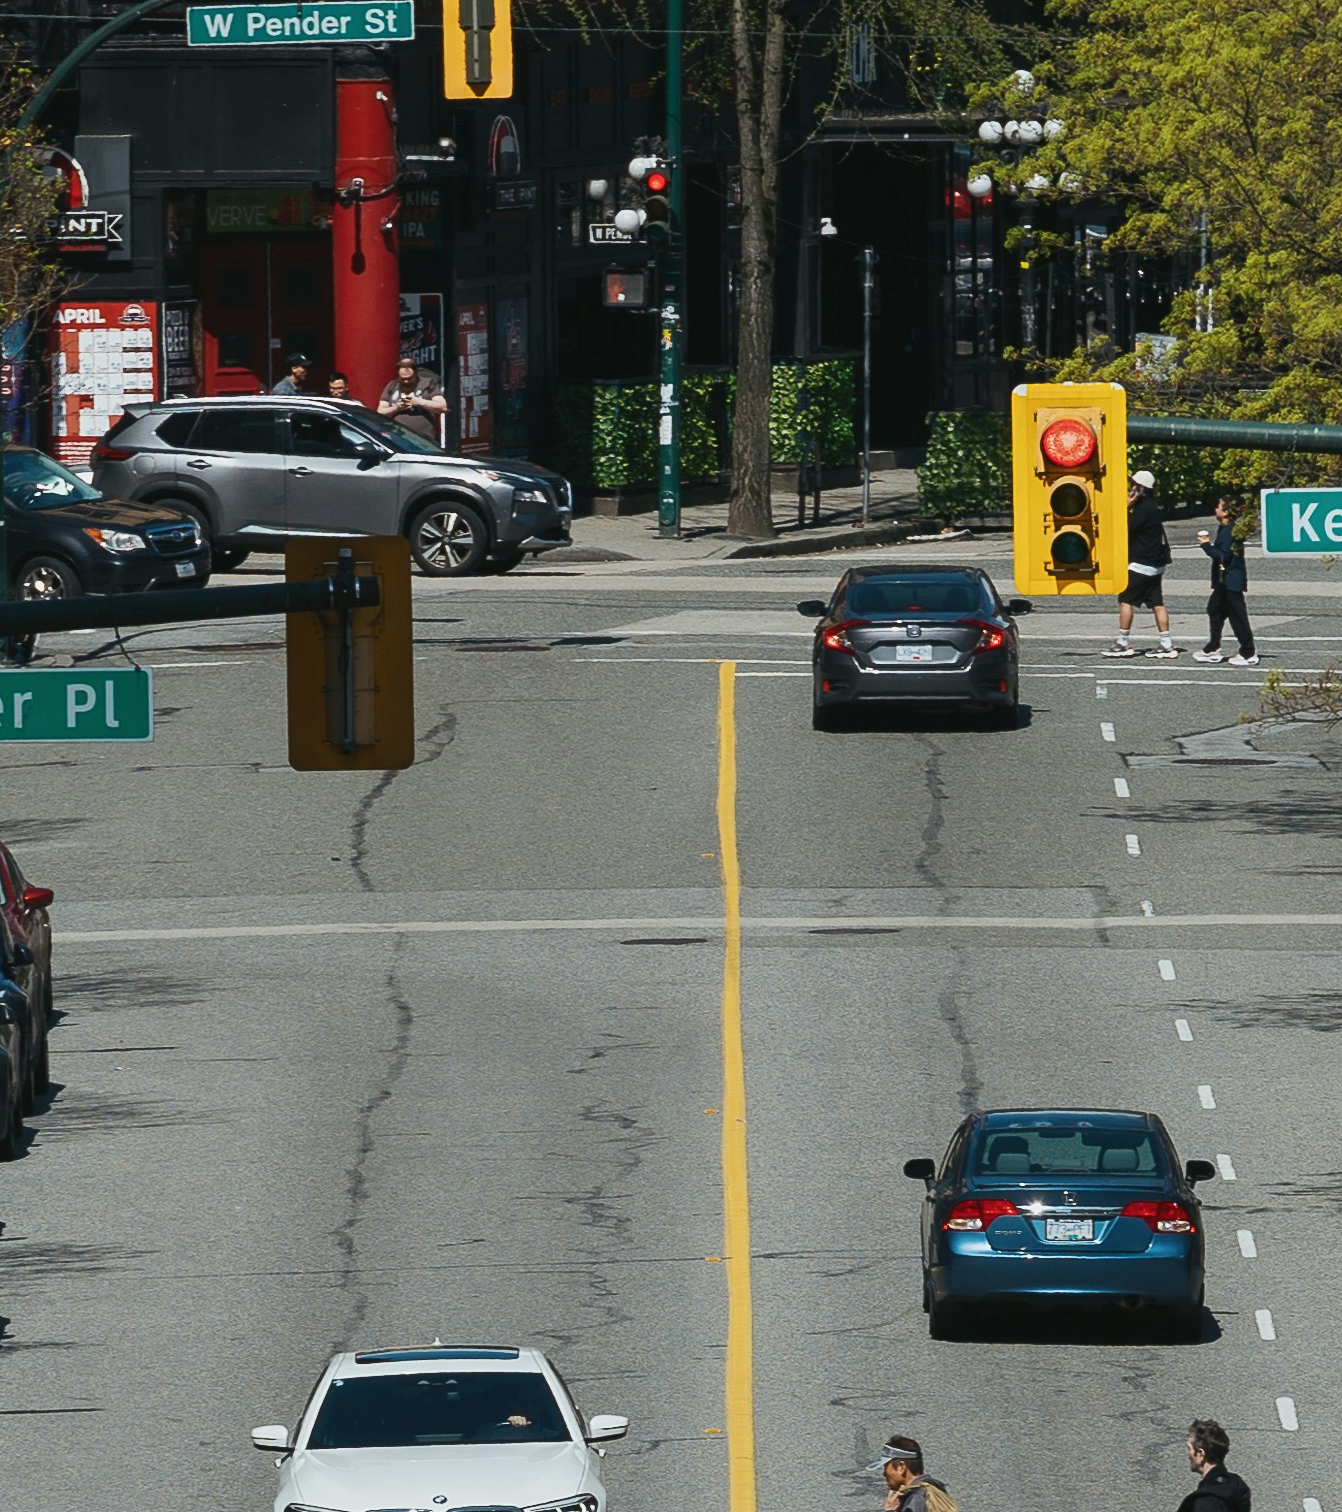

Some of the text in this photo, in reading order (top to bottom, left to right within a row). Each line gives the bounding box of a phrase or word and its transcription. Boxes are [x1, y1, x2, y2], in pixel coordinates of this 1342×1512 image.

[203, 8, 398, 39] W Pender St
[207, 205, 267, 228] VERVE
[53, 308, 106, 325] APRIL
[65, 681, 120, 731] Pl
